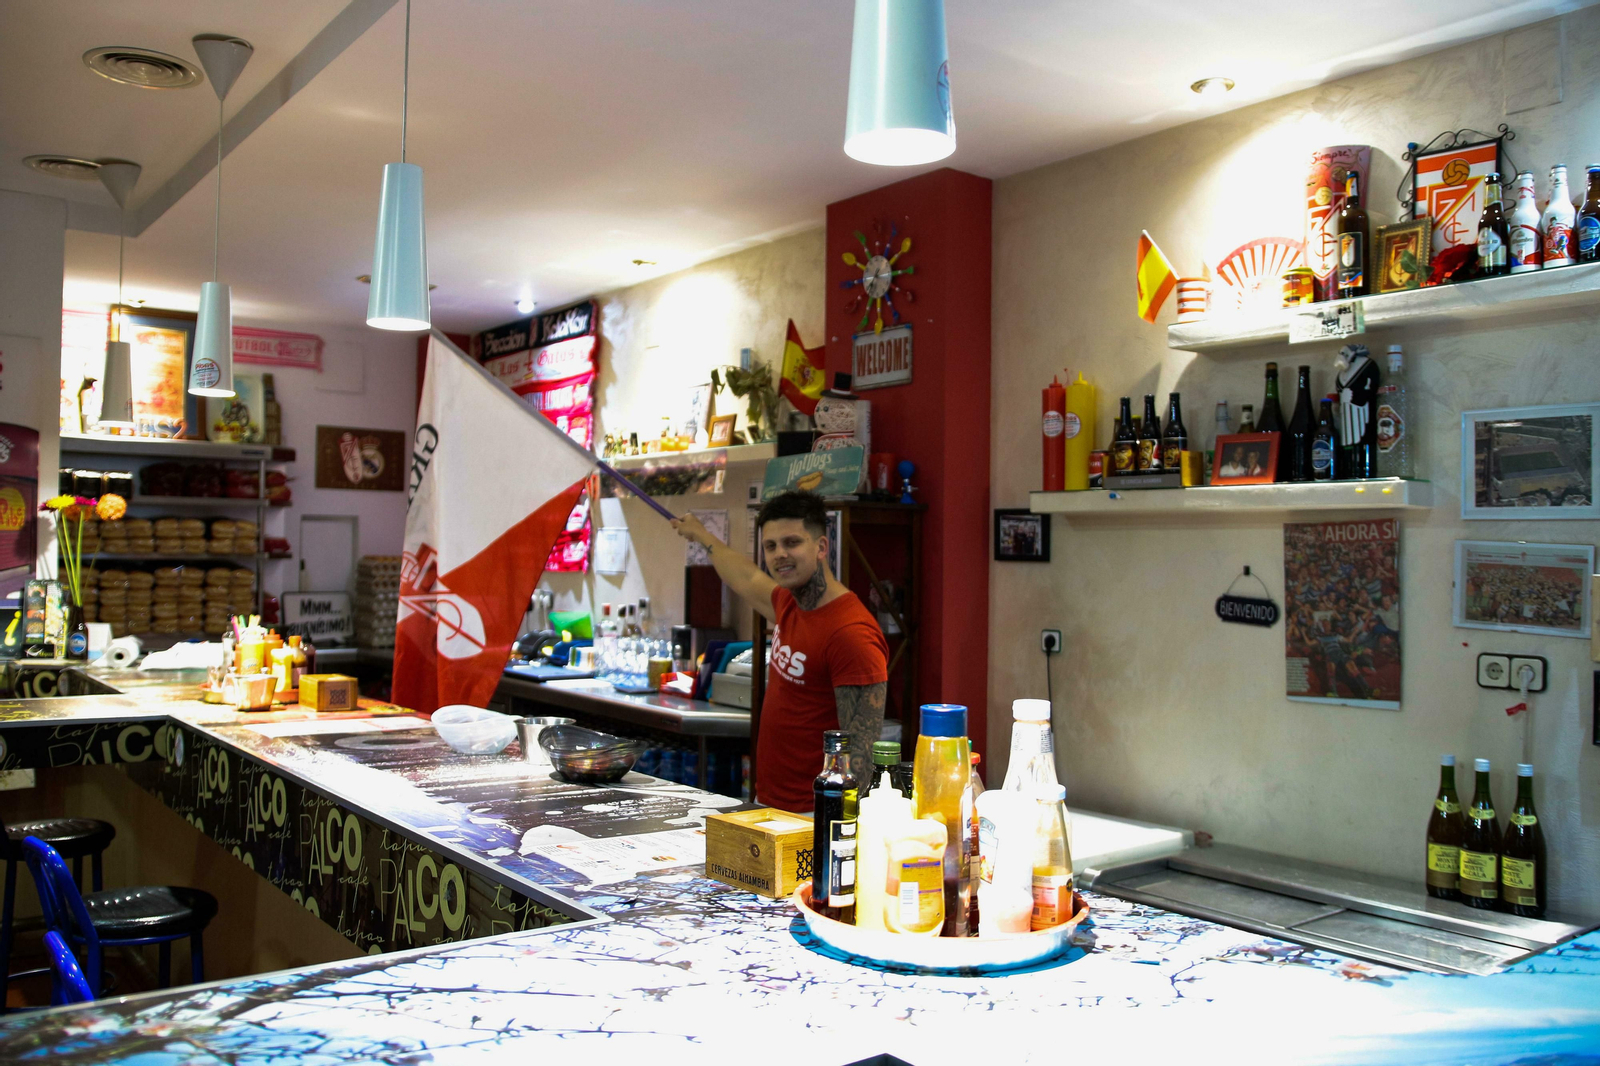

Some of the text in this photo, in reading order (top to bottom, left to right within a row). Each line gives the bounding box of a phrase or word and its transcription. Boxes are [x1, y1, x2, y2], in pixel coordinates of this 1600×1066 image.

[856, 336, 909, 377] WELCOME
[1325, 523, 1380, 542] AHORA
[1220, 600, 1275, 622] BIENVENIDO
[191, 746, 230, 808] PALCO
[239, 773, 287, 842] PALCO
[268, 812, 292, 861] café
[300, 807, 362, 887] PALCO
[338, 856, 369, 913] café
[711, 863, 738, 880] CERVEZAS
[379, 854, 466, 945] PALCO
